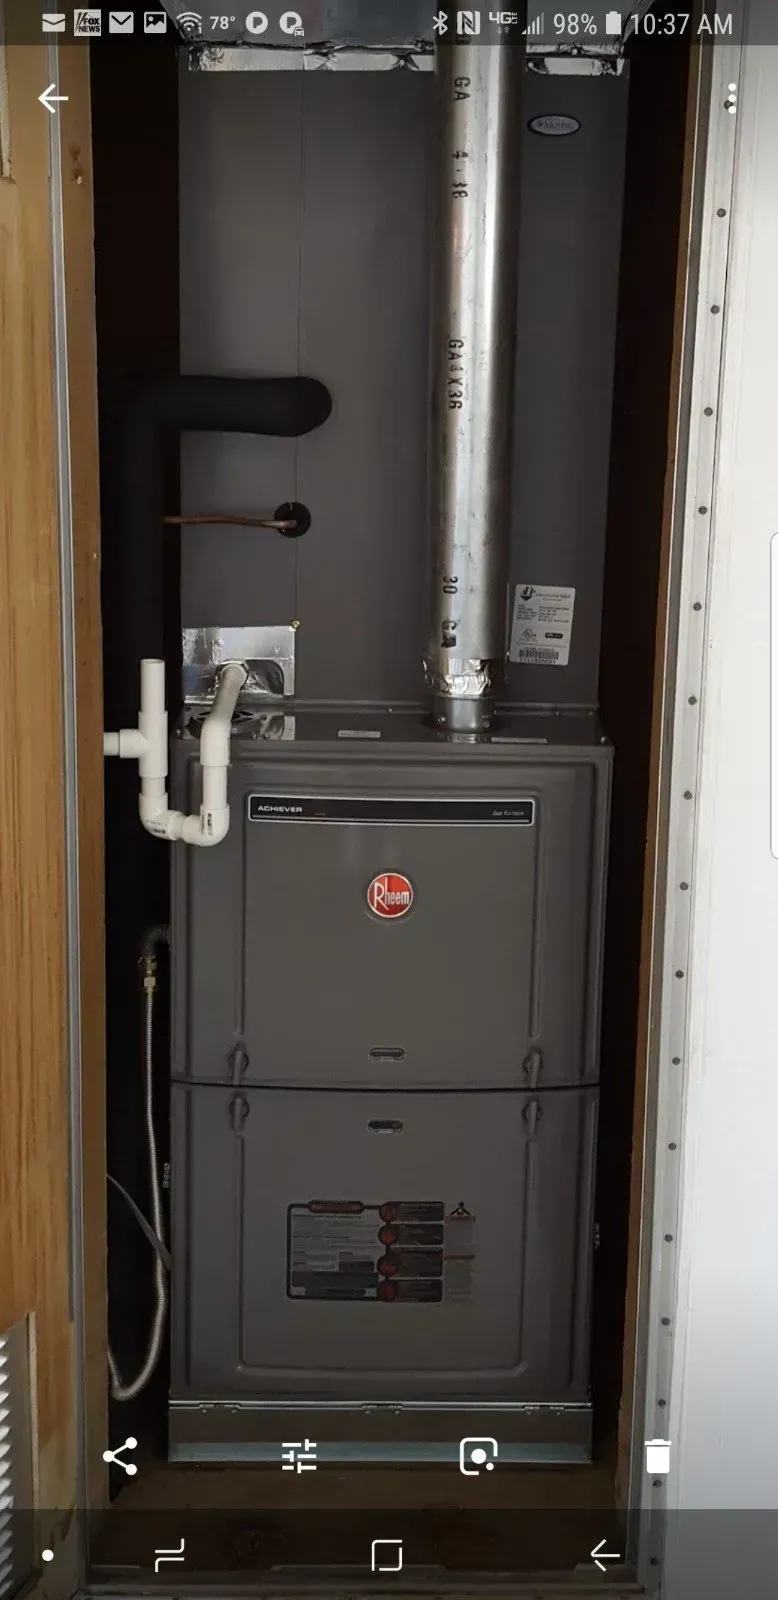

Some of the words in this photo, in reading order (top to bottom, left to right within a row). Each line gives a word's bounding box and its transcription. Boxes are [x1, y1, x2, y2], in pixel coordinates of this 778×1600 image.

[443, 575, 458, 595] 30
[257, 804, 303, 813] ACHIEVER
[373, 876, 410, 911] Rheem
